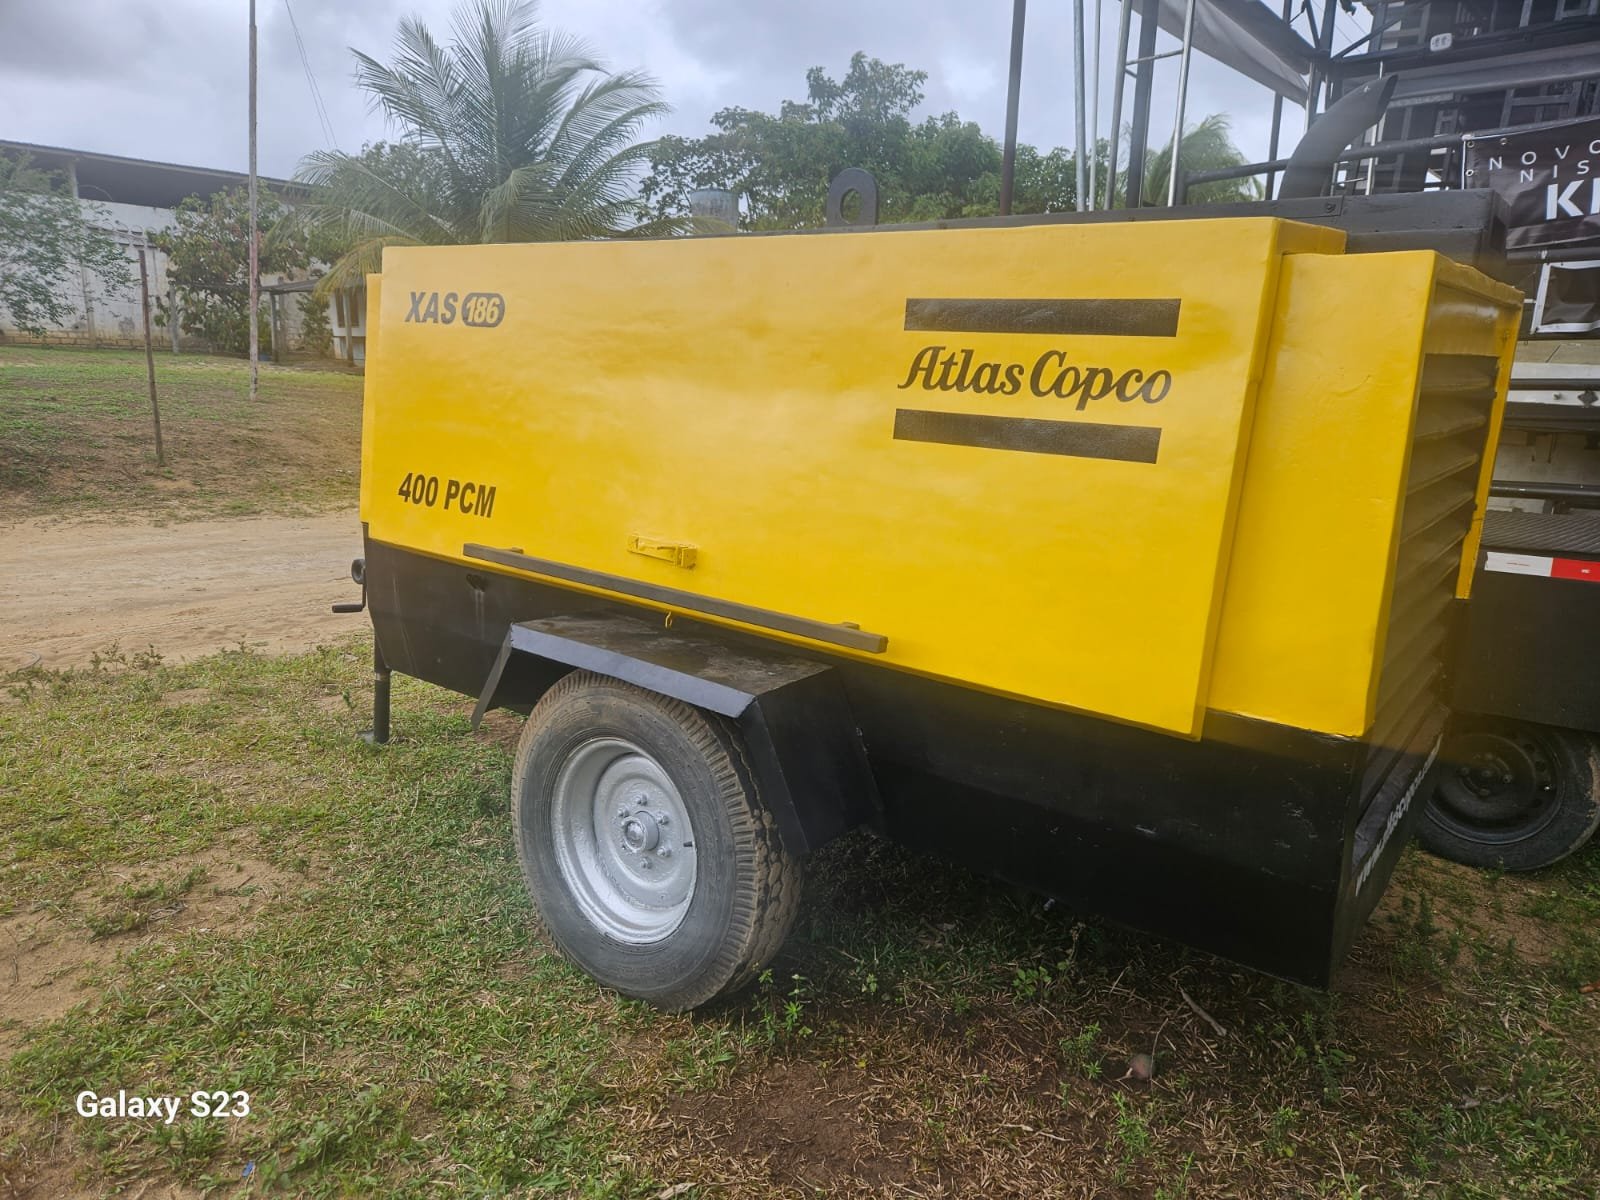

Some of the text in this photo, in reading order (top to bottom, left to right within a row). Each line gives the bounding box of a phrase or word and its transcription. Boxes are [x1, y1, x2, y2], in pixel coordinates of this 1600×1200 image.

[404, 291, 501, 325] XAS 186
[897, 345, 1172, 411] Atlas Copco
[398, 472, 497, 518] 400 PCM
